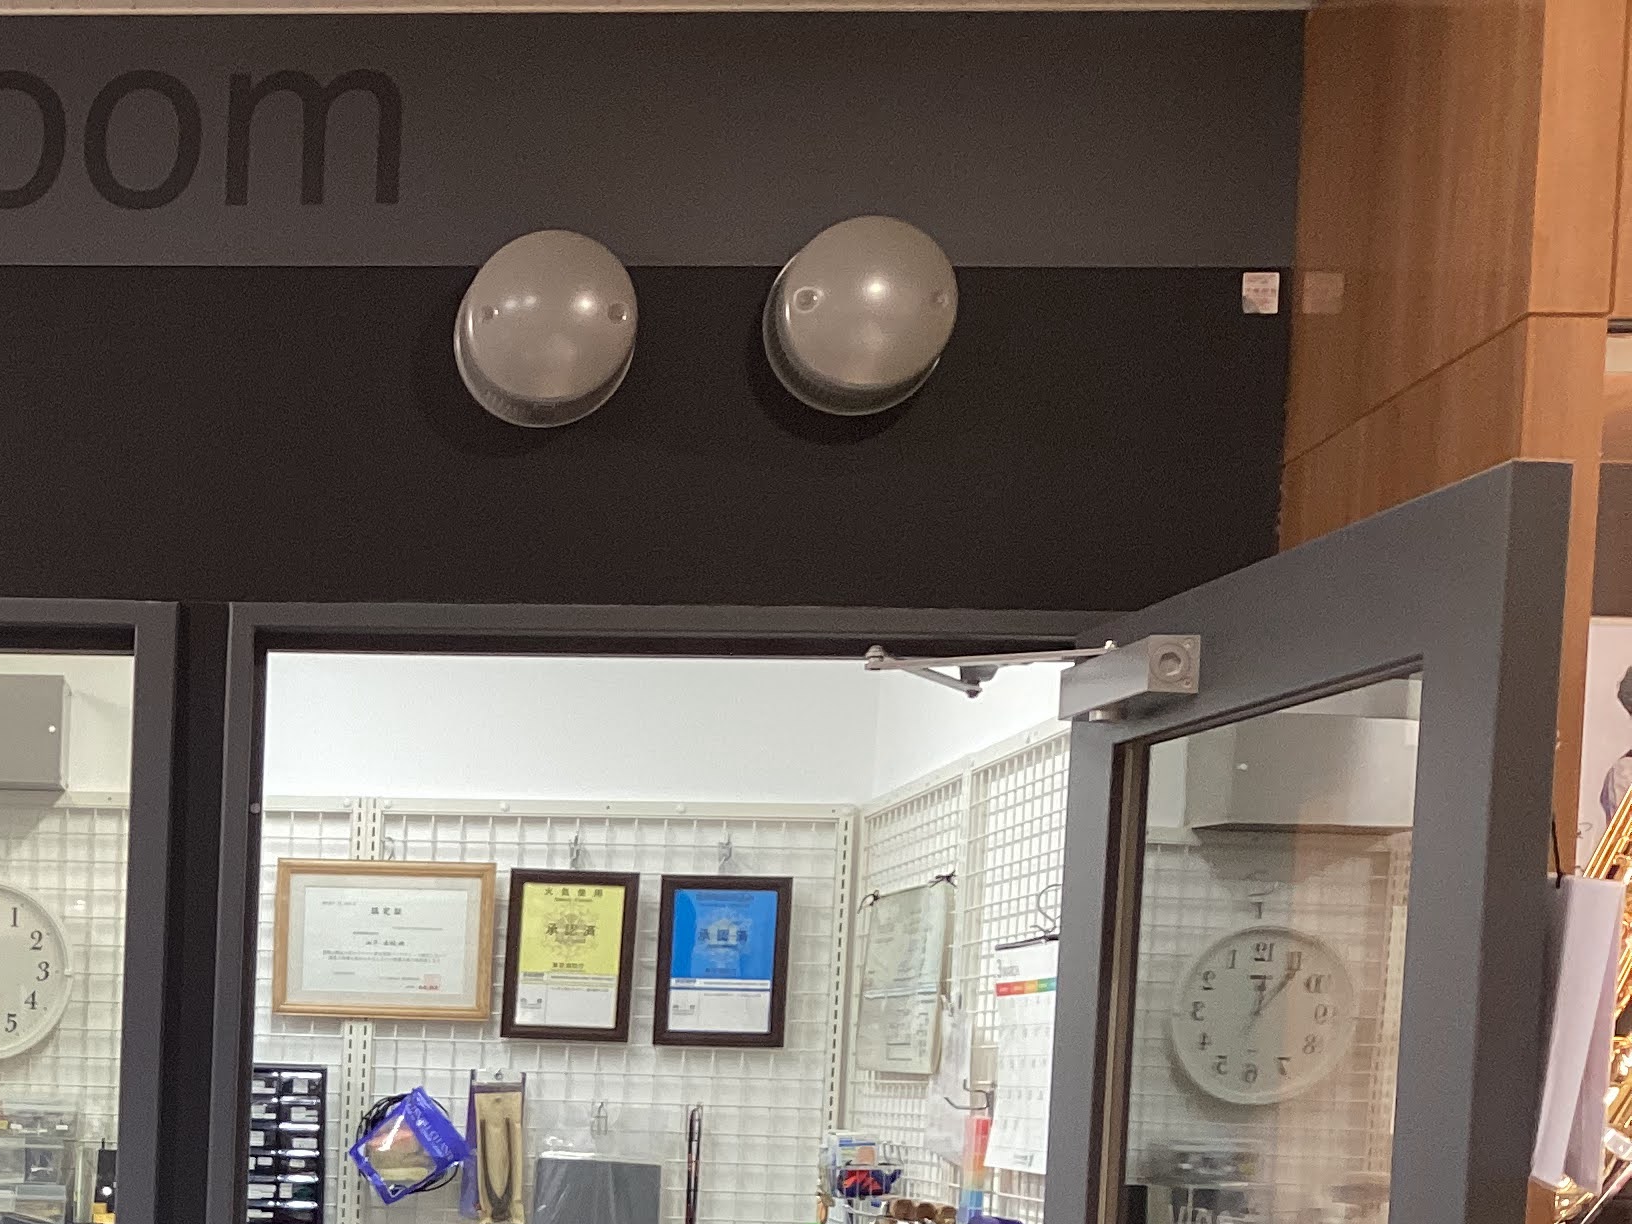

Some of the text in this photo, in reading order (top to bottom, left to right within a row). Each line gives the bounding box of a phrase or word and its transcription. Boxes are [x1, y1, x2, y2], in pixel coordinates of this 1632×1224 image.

[11, 907, 19, 927] 1
[30, 931, 43, 950] 2
[36, 962, 50, 981] 3
[24, 990, 38, 1010] 4
[5, 1013, 17, 1033] 5
